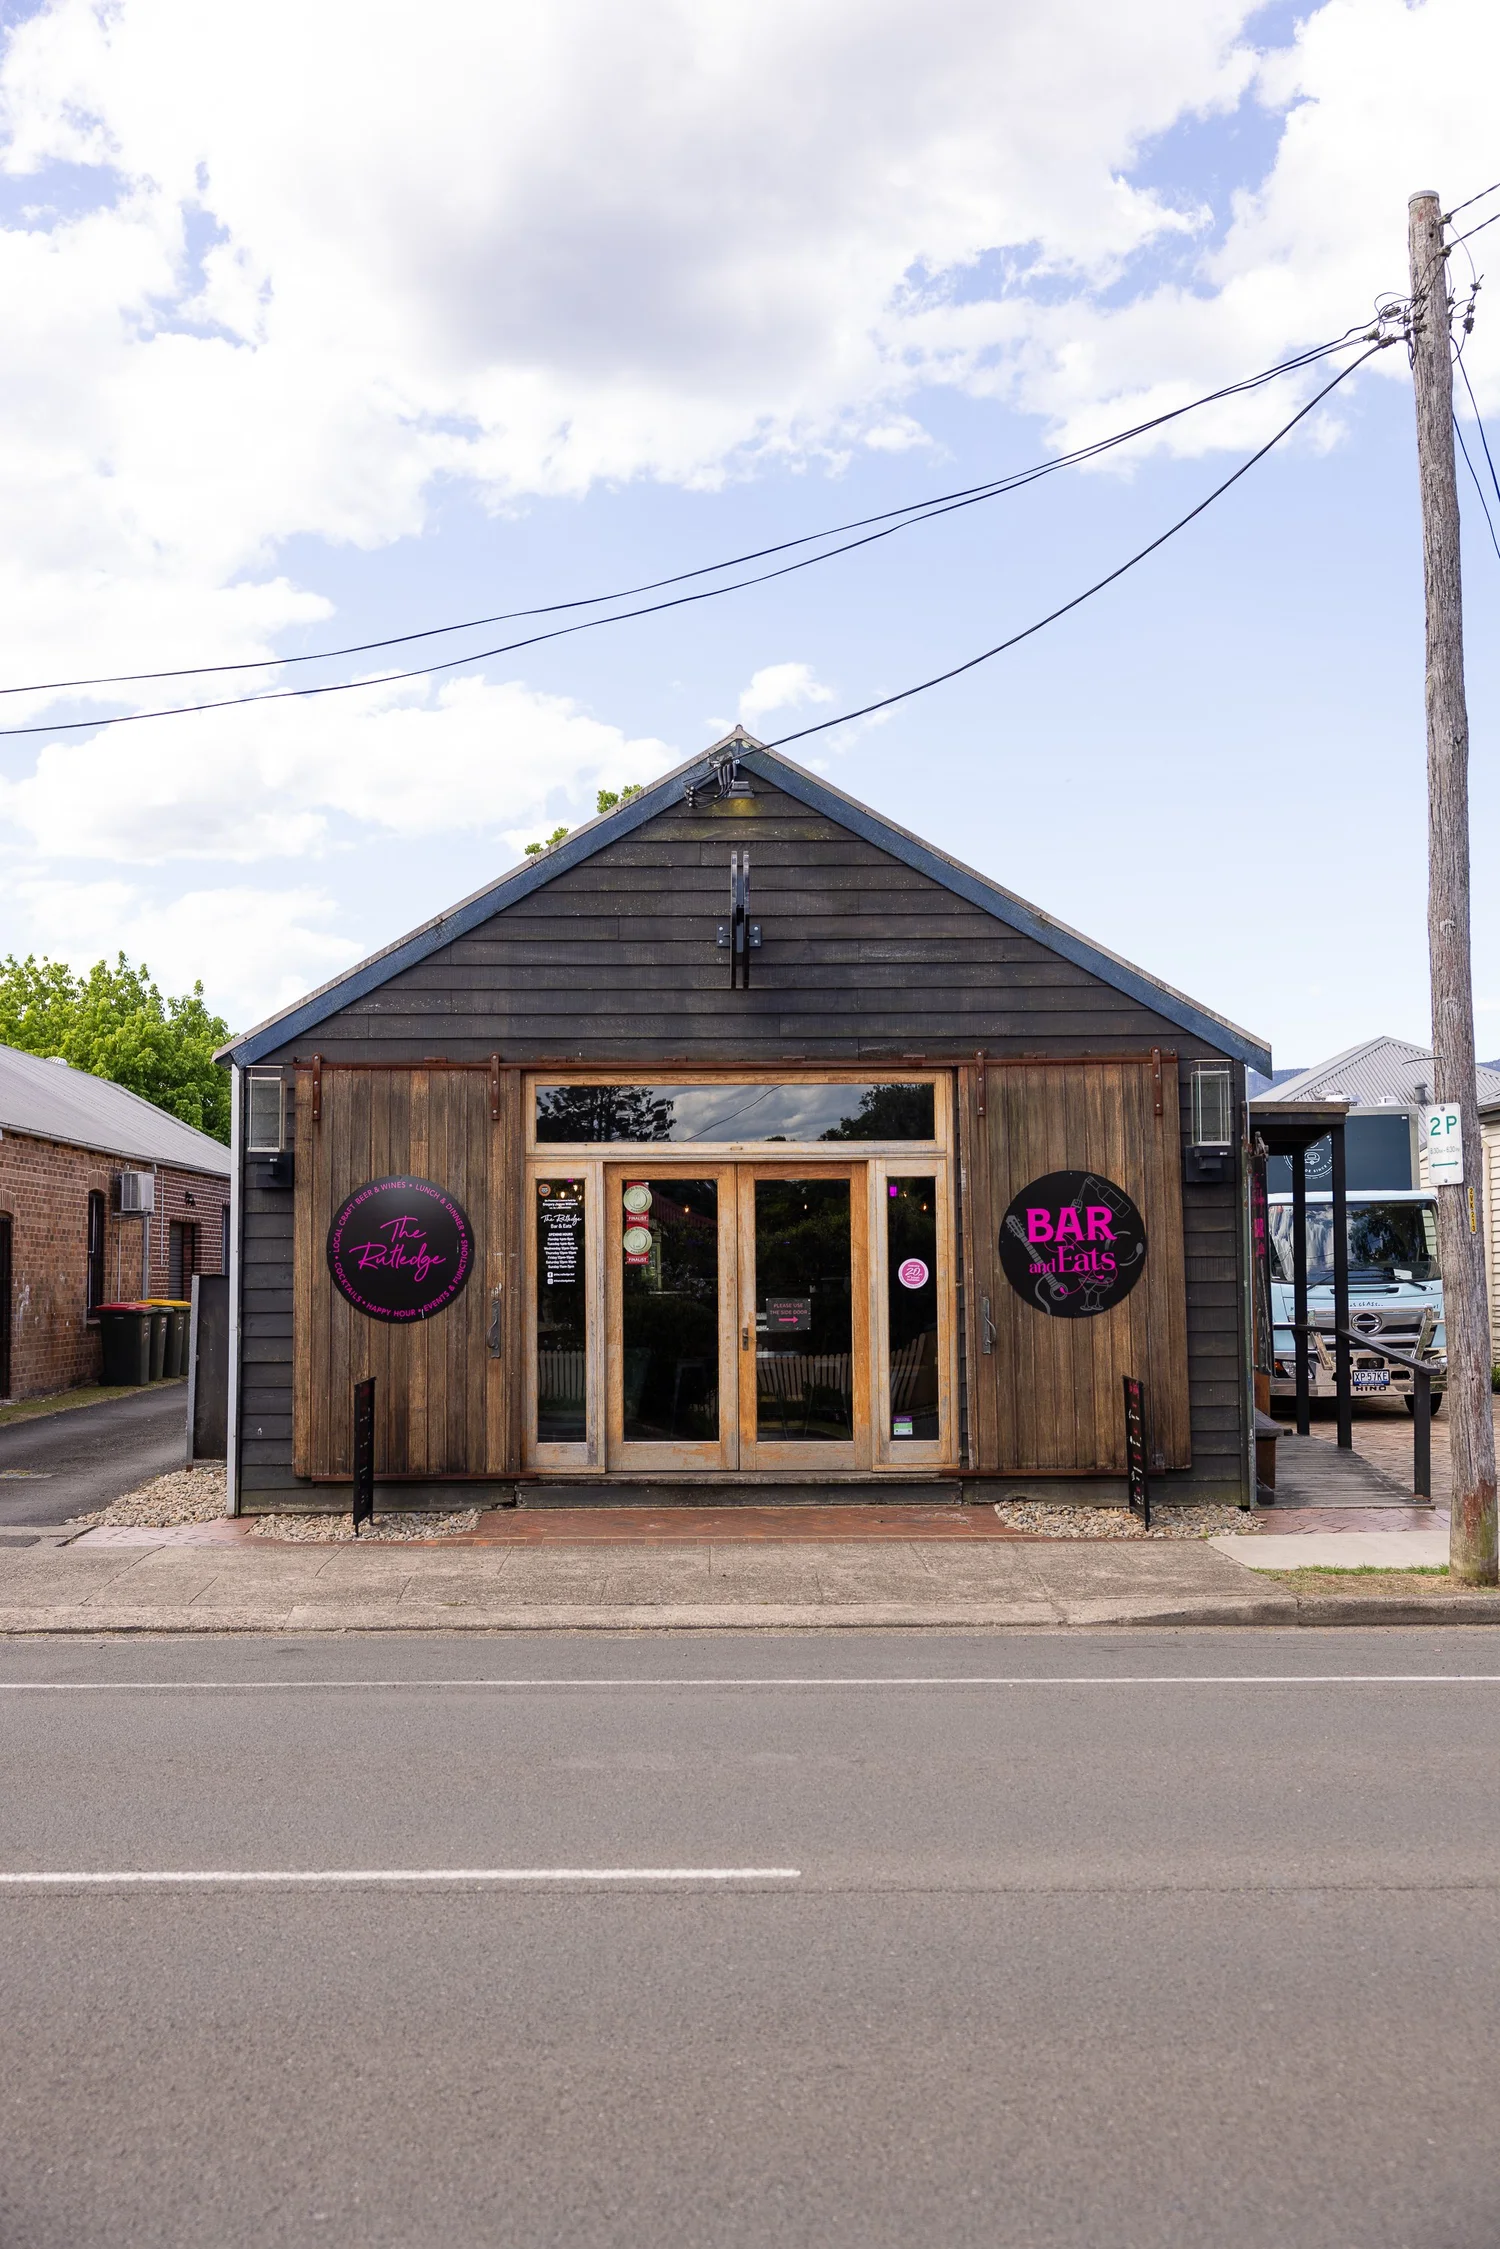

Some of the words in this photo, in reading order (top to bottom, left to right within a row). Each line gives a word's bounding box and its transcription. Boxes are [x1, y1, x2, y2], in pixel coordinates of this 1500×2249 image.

[1430, 1115, 1457, 1136] 2P
[332, 1229, 343, 1253] LOCAL
[339, 1204, 356, 1227] CRAFT
[355, 1189, 373, 1205] BEER
[381, 1181, 406, 1191] WINES
[415, 1183, 439, 1199] LUNCH
[439, 1197, 446, 1205] &
[445, 1203, 465, 1231] DINNER
[1026, 1206, 1117, 1243] BAR
[379, 1215, 427, 1243] The
[348, 1241, 447, 1283] Rutledge
[423, 1291, 450, 1312] EVENTS
[448, 1284, 456, 1292] &
[453, 1239, 468, 1285] FUNCTIONS
[1029, 1258, 1056, 1274] and
[1057, 1245, 1116, 1273] Eats
[334, 1262, 362, 1303] COCKTAILS
[366, 1302, 392, 1317] HAPPY
[393, 1308, 416, 1318] HOUR
